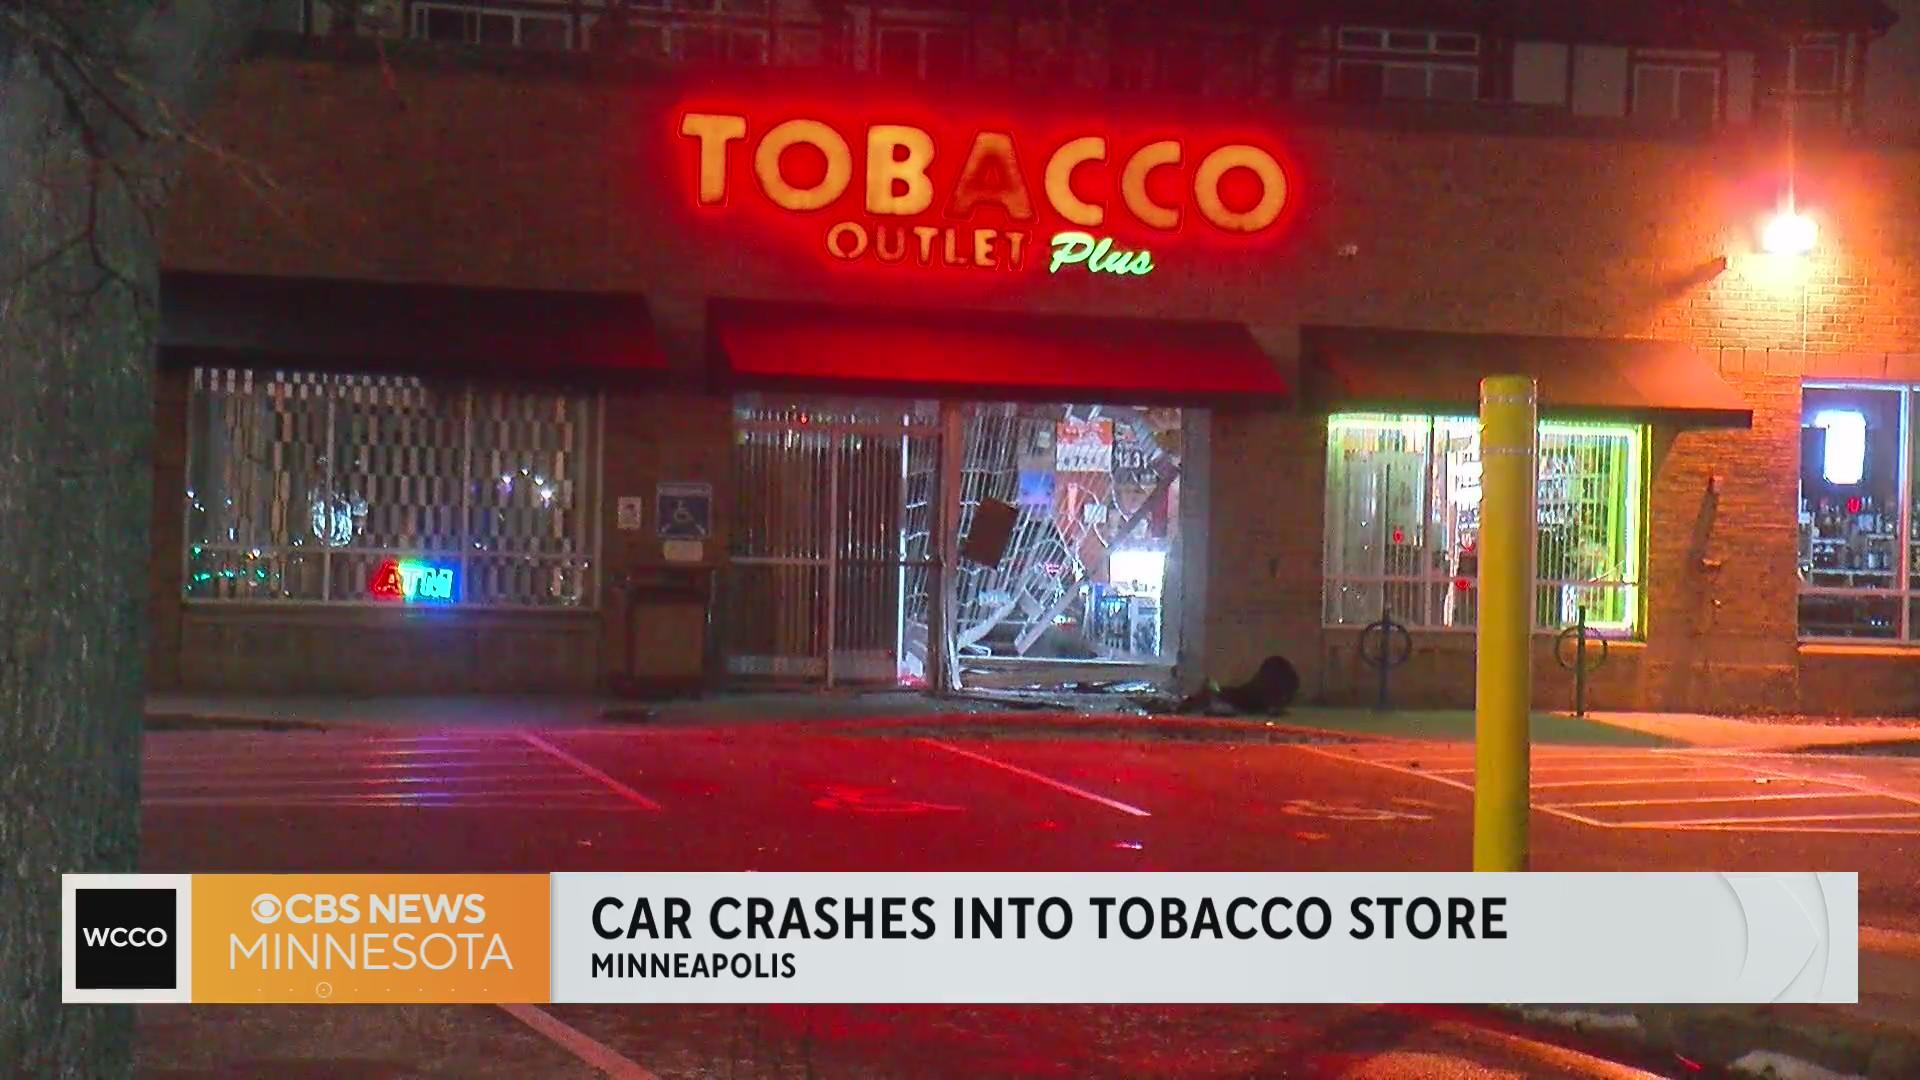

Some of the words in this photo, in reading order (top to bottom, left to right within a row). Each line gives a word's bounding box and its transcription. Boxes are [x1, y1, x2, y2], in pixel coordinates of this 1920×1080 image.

[680, 113, 1288, 233] TOBACCO
[826, 221, 1025, 267] OUTLET
[1049, 231, 1154, 275] Plus
